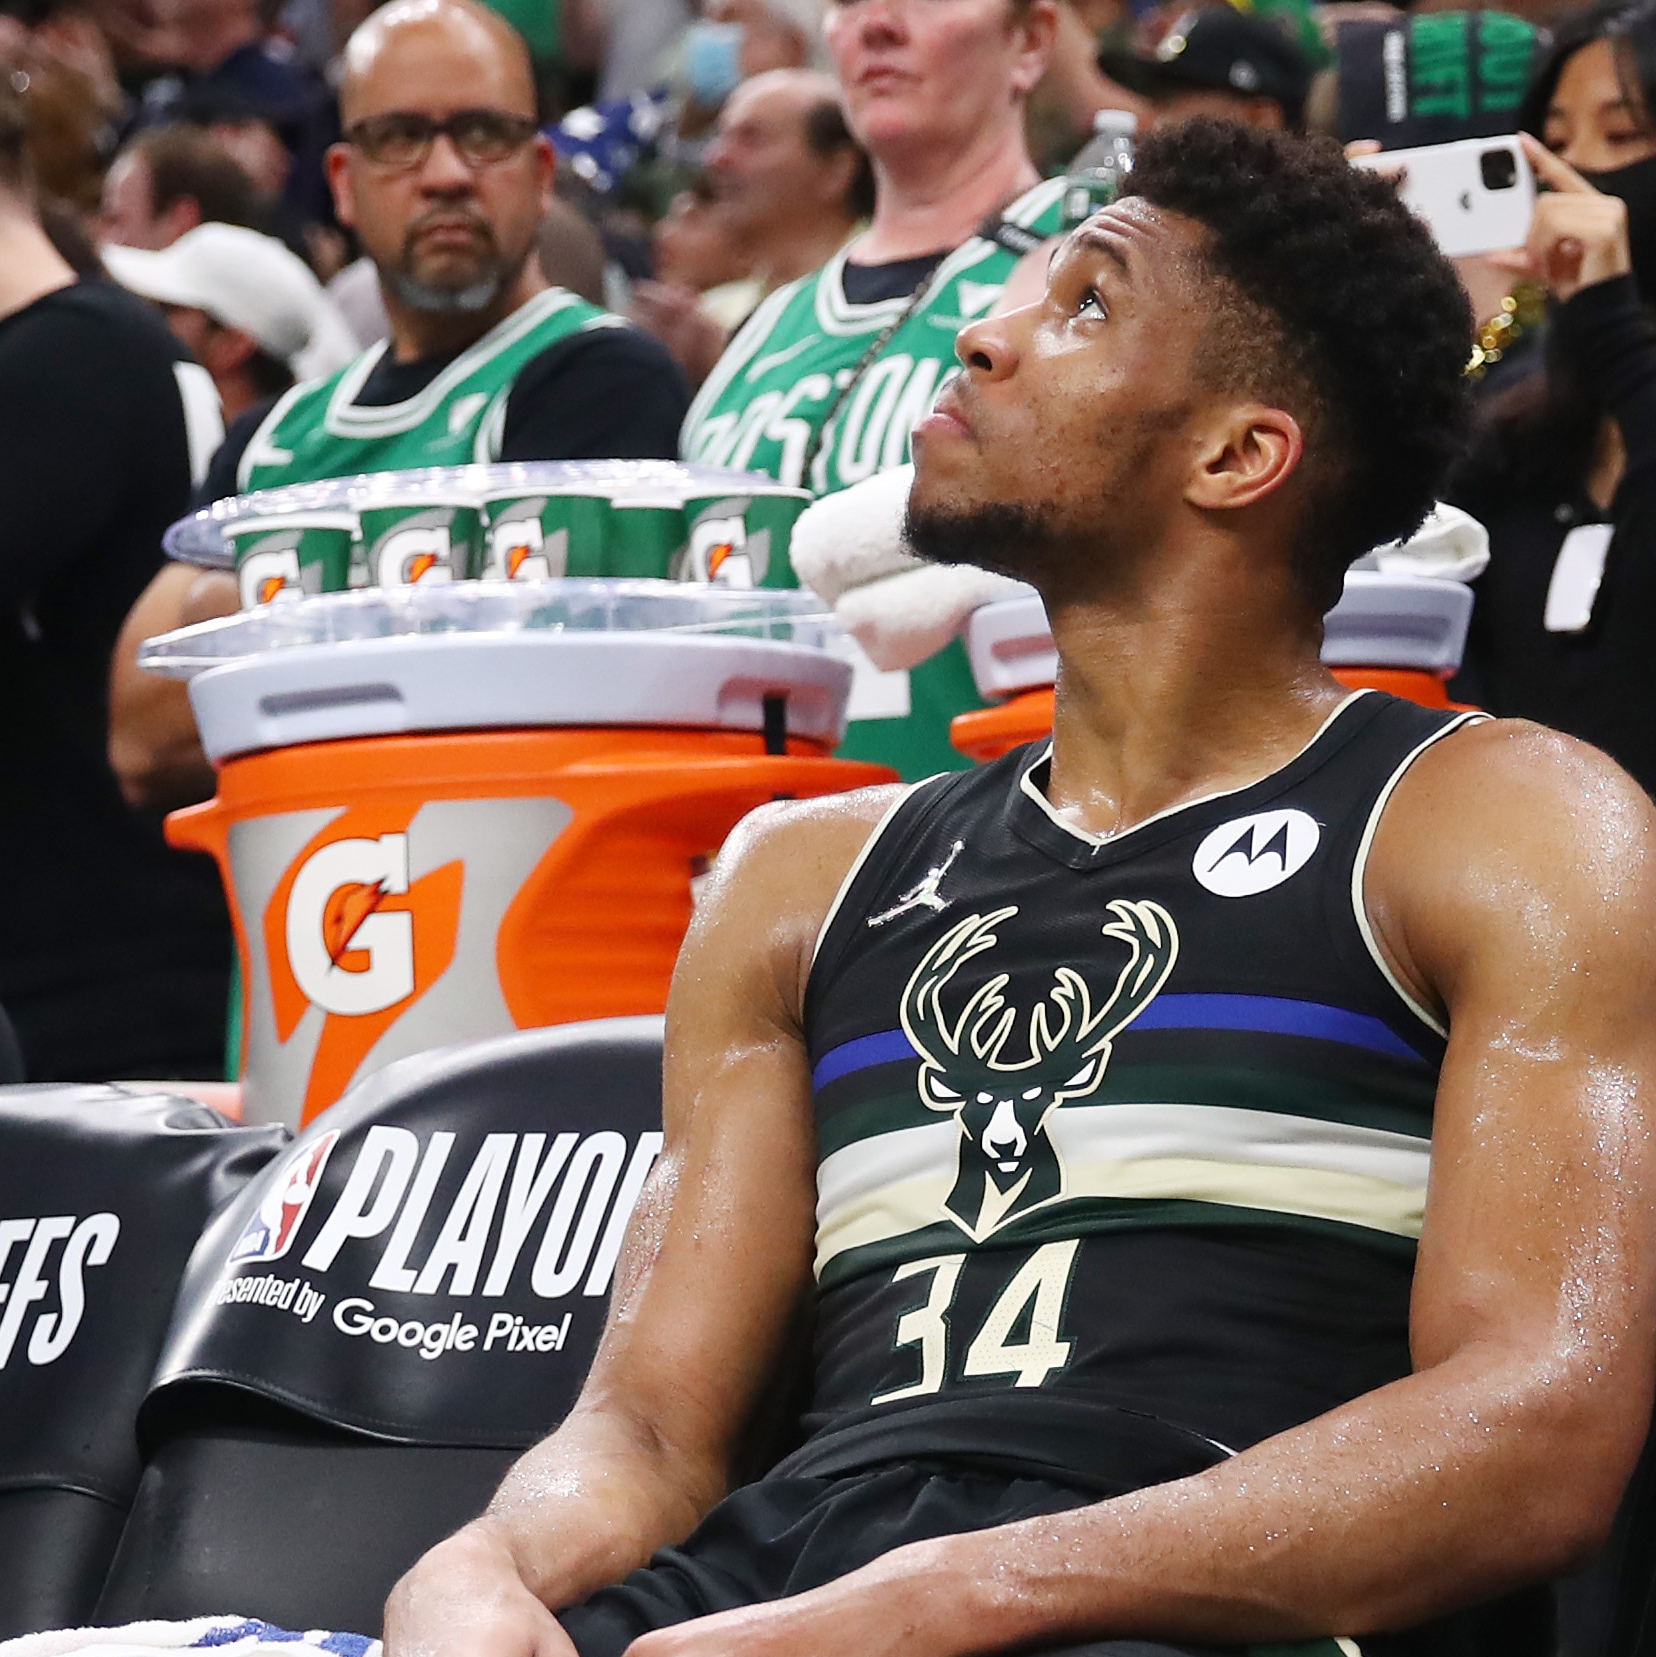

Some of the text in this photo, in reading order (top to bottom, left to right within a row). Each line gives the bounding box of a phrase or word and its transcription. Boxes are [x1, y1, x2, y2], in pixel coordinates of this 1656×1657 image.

[286, 833, 415, 1016] G
[293, 1281, 326, 1323] by
[333, 1298, 479, 1360] Google
[483, 1312, 573, 1352] Pixel
[870, 1238, 1081, 1406] 34
